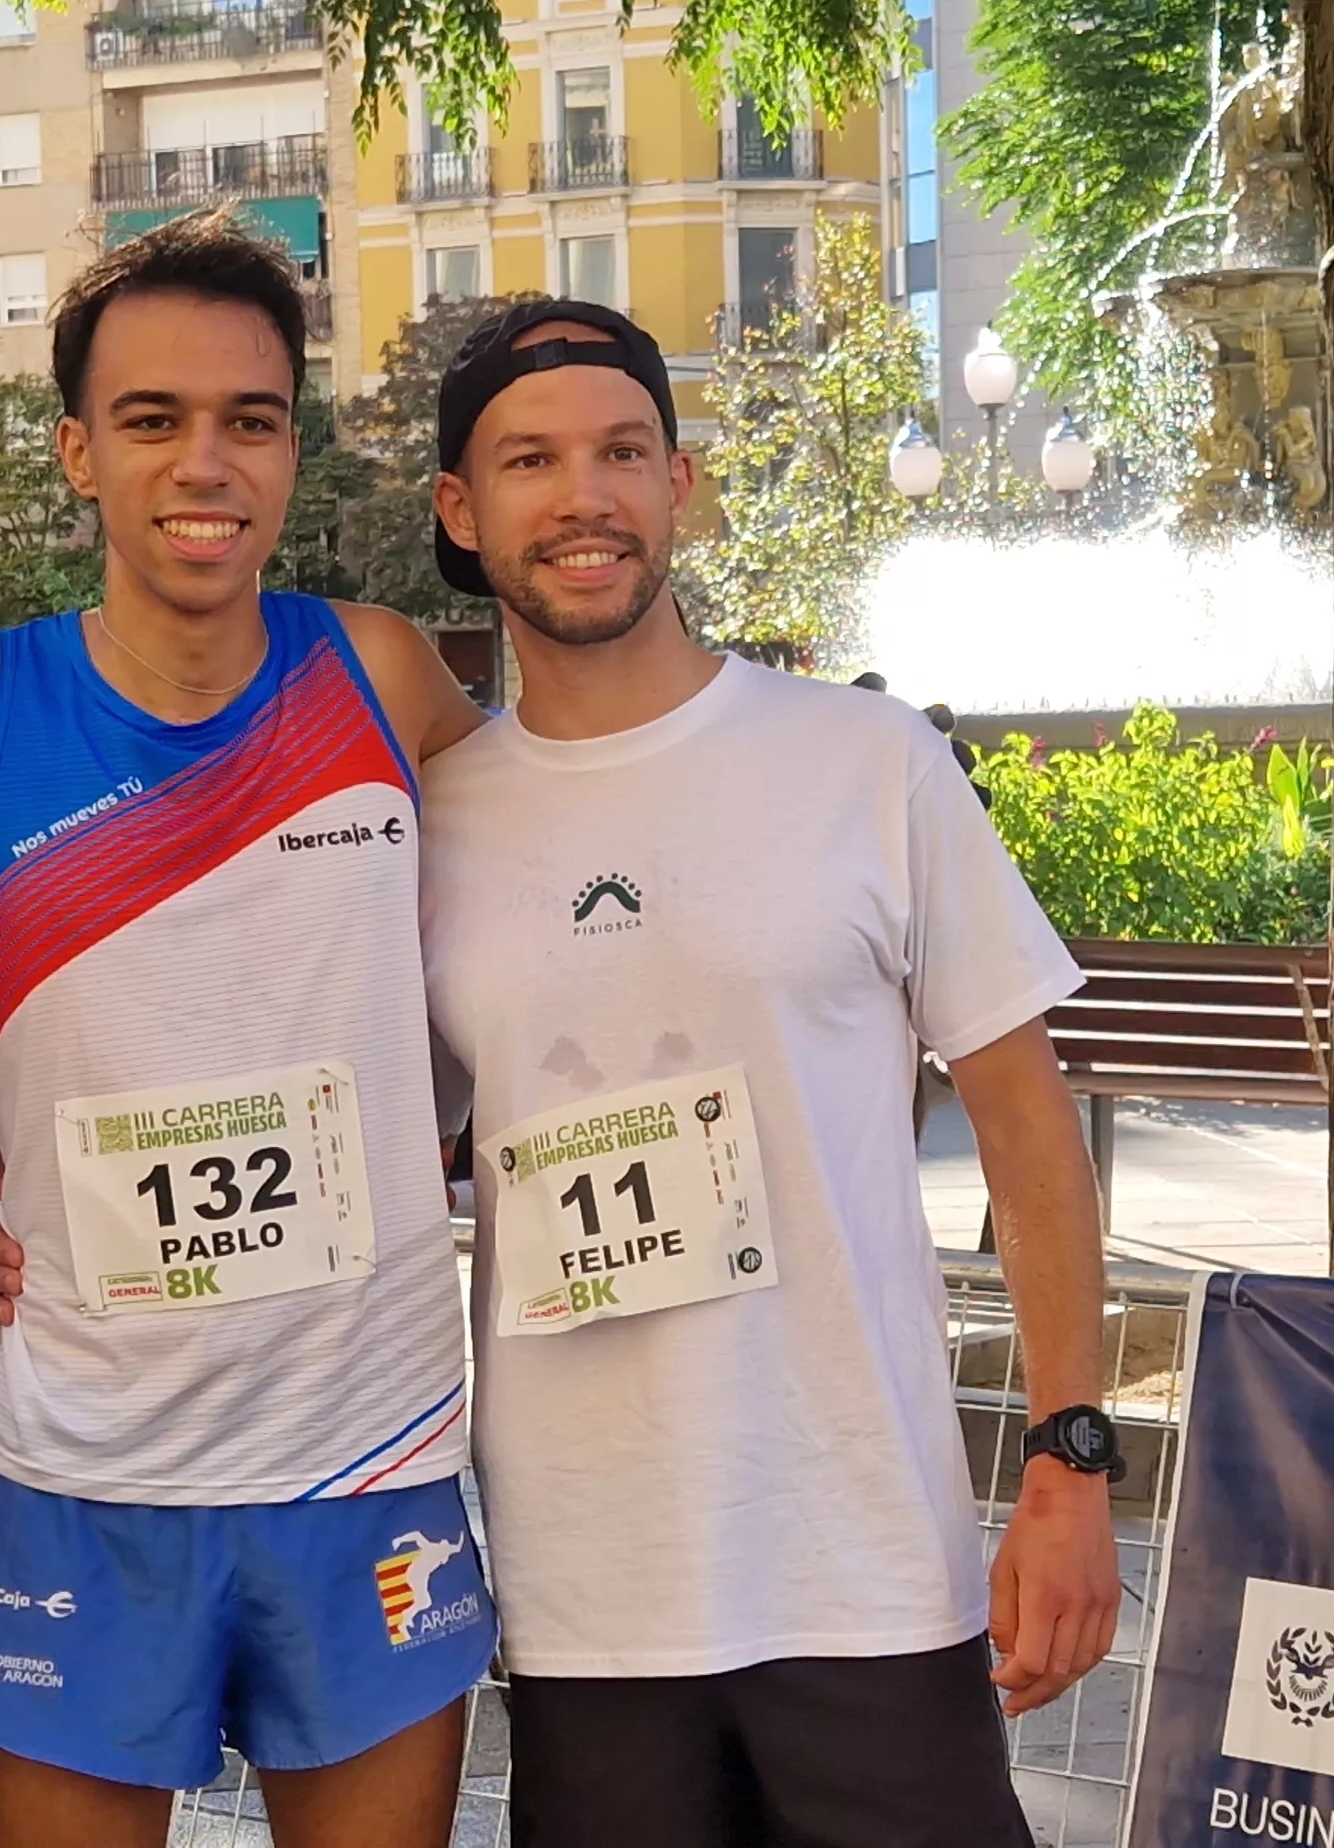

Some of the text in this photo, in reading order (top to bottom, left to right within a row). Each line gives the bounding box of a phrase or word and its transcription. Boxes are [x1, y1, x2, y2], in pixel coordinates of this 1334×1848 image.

[10, 776, 145, 860] Nos mueves TÚ
[277, 823, 374, 852] Ibercaja
[134, 1092, 285, 1131] III CARRERA
[136, 1111, 288, 1151] EMPRESAS HUESCA
[532, 1101, 676, 1151] III CARRERA
[535, 1120, 679, 1171] EMPRESAS HUESCA
[136, 1146, 298, 1228] 132
[560, 1160, 656, 1237] 11
[160, 1221, 285, 1265] PABLO
[559, 1229, 685, 1280] FELIPE
[166, 1264, 223, 1300] 8K
[569, 1275, 620, 1313] 8K
